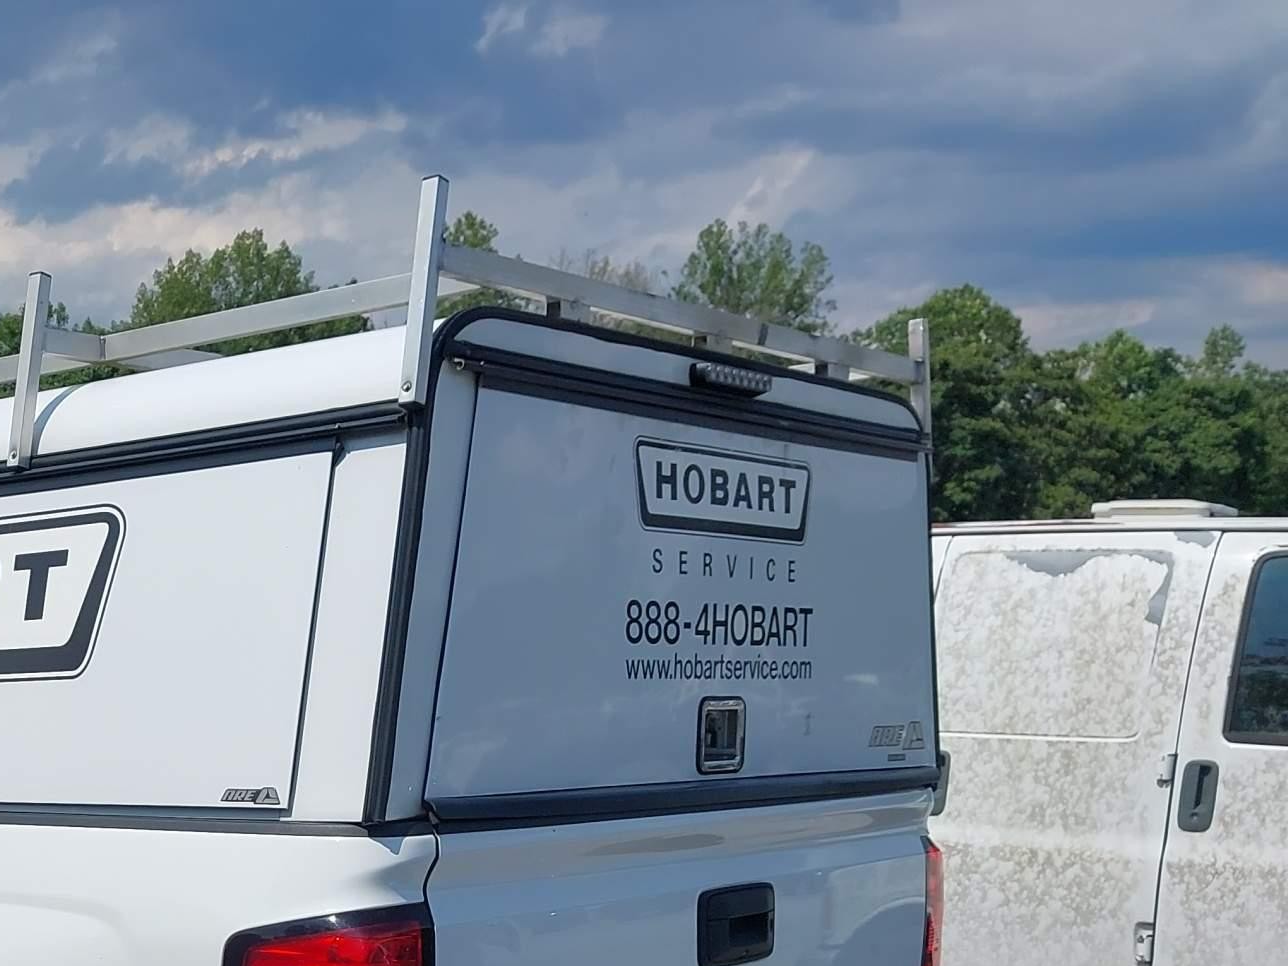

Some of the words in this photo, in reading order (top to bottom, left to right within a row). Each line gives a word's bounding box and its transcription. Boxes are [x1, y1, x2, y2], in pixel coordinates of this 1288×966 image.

[655, 461, 797, 514] HOBART
[652, 548, 796, 583] SERVICE
[625, 599, 813, 648] 888-4HOBART
[625, 652, 813, 681] www.hobartservice.com
